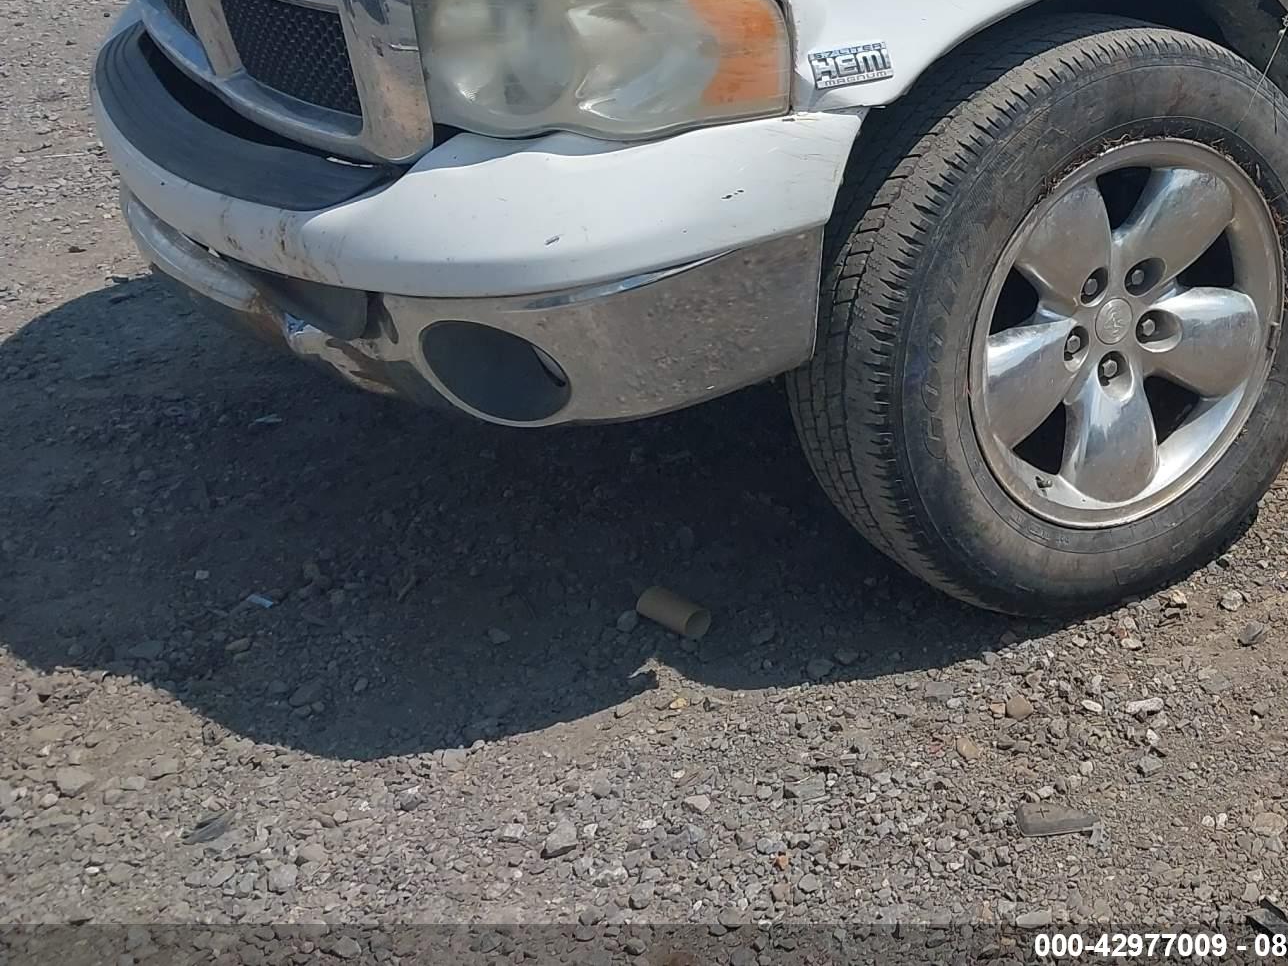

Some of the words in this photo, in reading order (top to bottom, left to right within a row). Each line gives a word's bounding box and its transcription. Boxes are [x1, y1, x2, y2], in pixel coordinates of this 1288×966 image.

[837, 42, 883, 56] LITER
[811, 48, 892, 81] HEMI
[824, 70, 888, 87] MAGNUM
